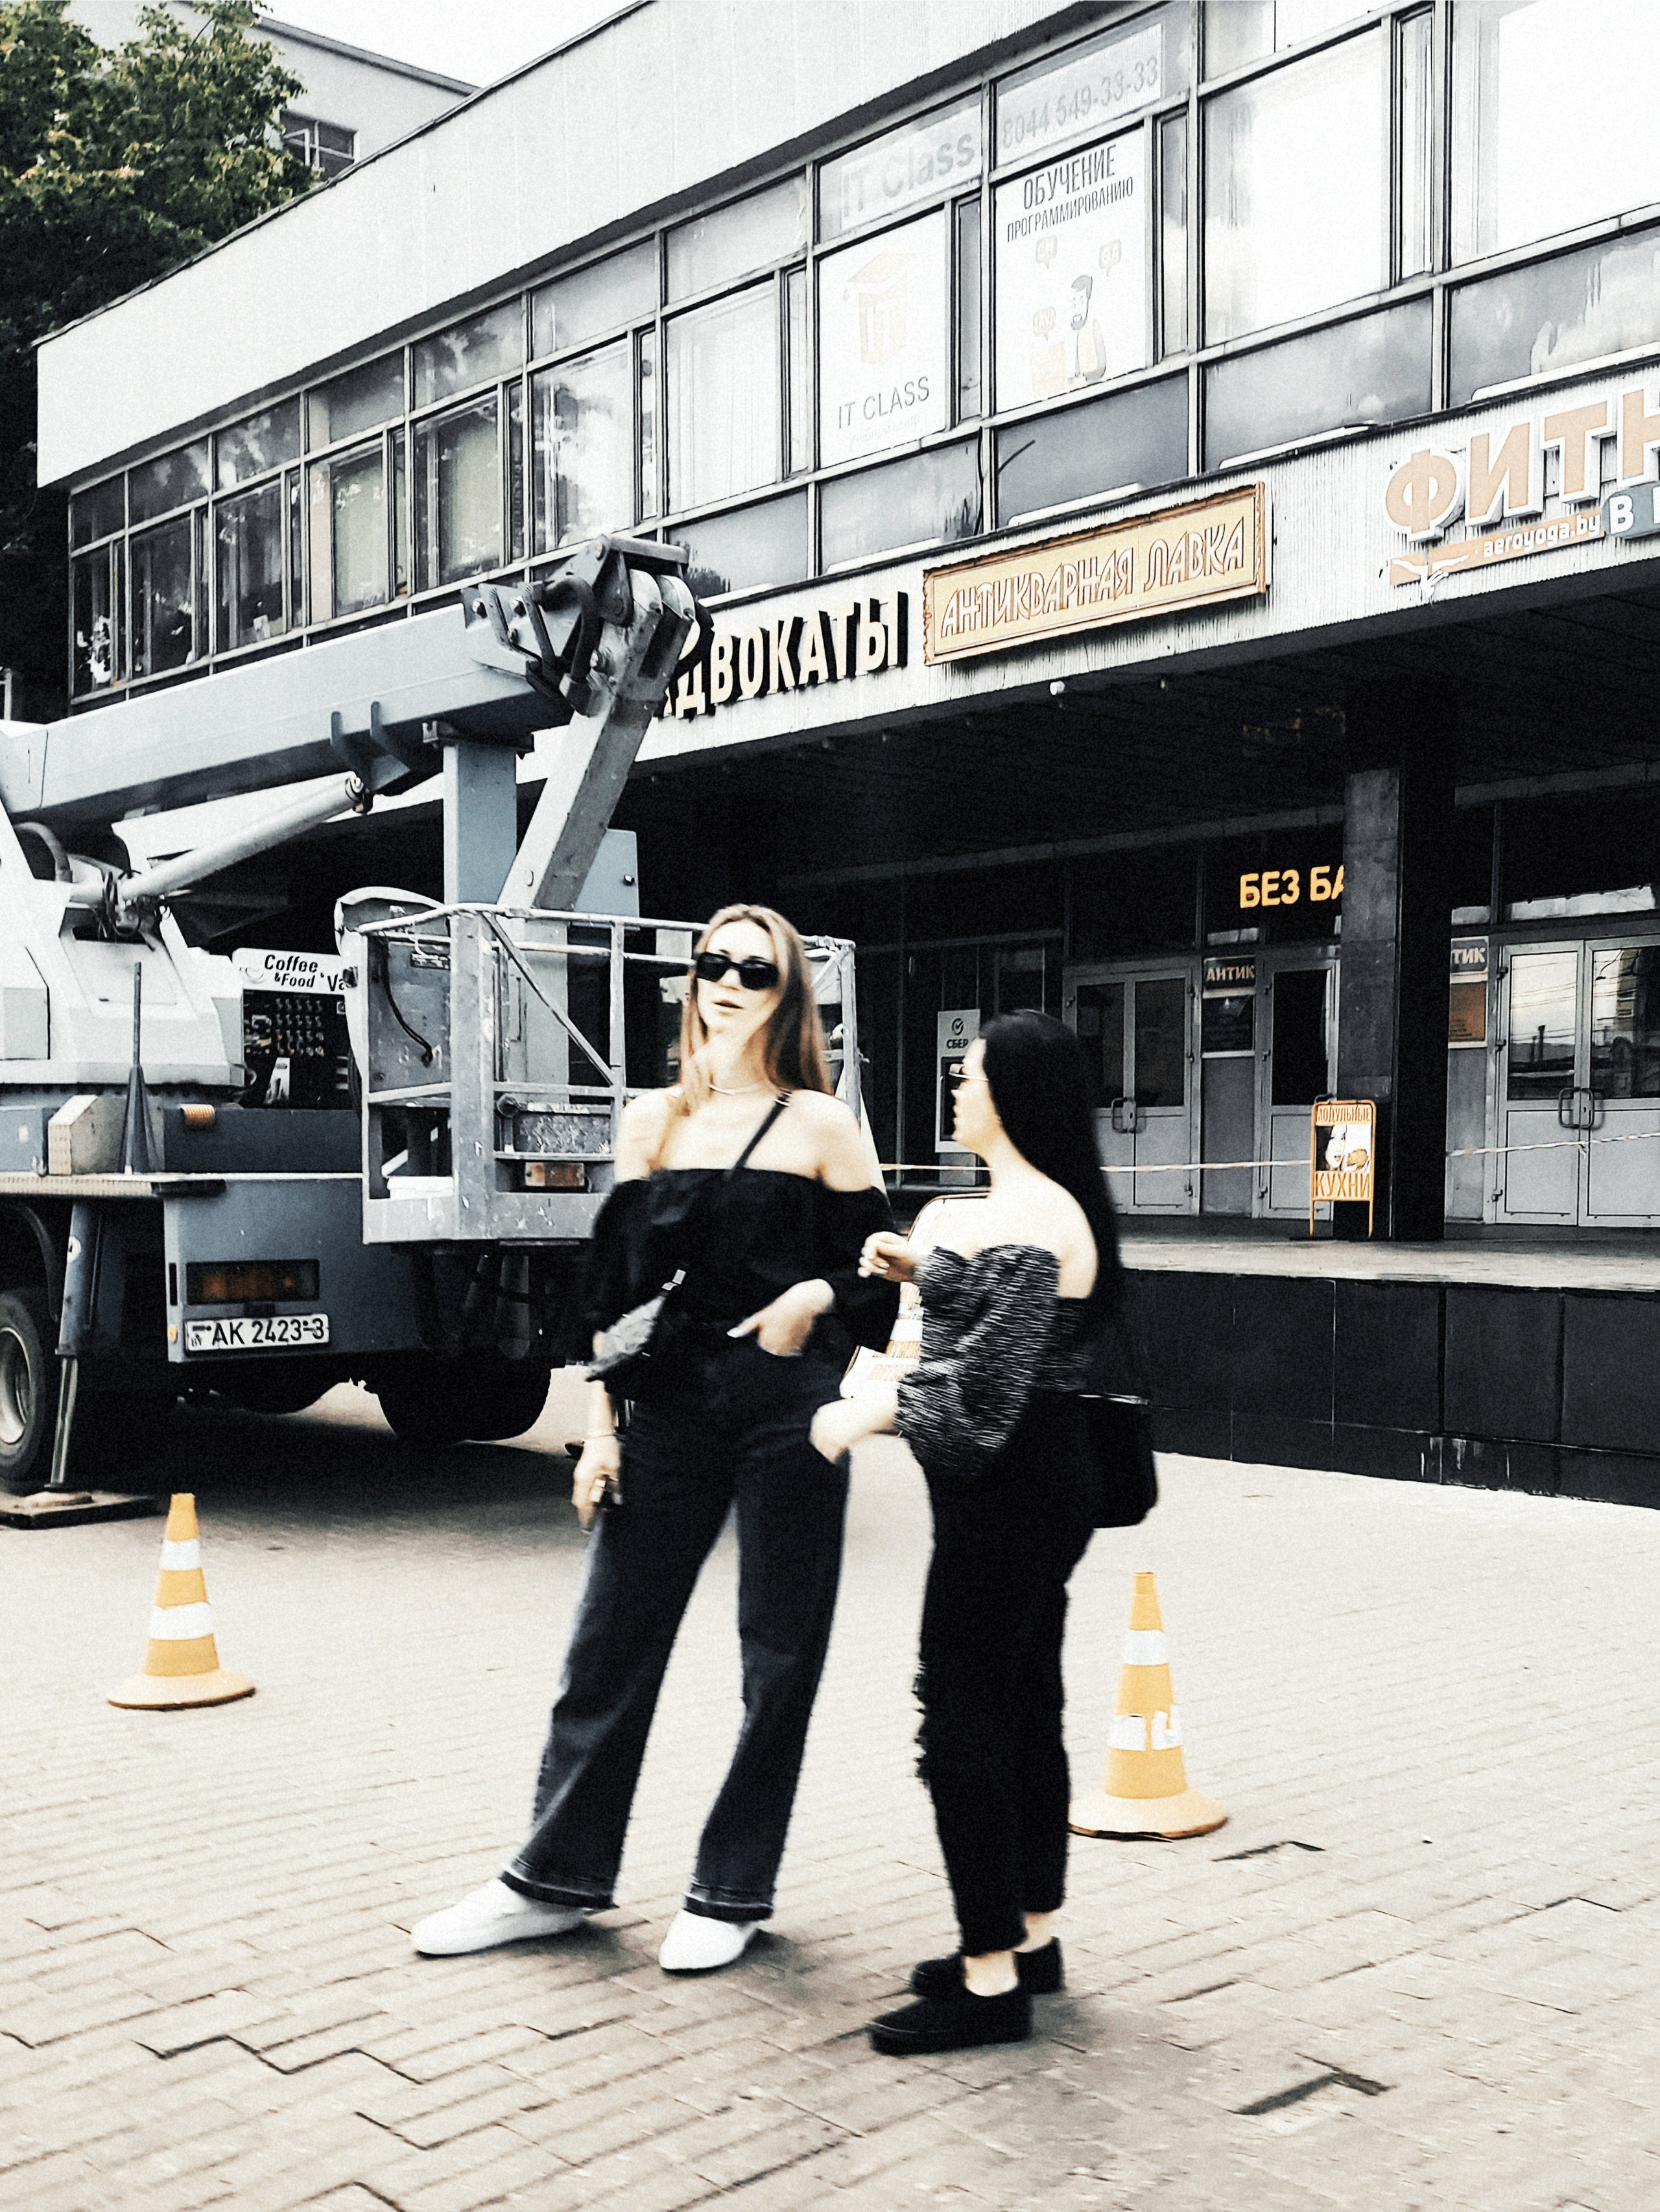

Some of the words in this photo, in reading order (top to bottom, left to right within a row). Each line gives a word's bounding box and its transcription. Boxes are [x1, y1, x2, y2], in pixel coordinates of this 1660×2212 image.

[1003, 101, 1049, 149] 8044
[1056, 54, 1157, 126] 549-33-33
[844, 163, 870, 217] IT
[883, 134, 974, 197] Class
[1024, 144, 1116, 209] ОБУЧЕНИЕ
[1008, 176, 1133, 243] ПРОГРАММИРОВАНИЮ
[839, 402, 855, 429] IT
[864, 376, 929, 420] CLASS
[1483, 514, 1601, 558] aeroyoga.by
[941, 547, 1134, 638] АНТИКВАРНАЯ
[1143, 516, 1244, 593] ЛАВКА
[663, 591, 899, 719] ДВОКАТЫ
[1239, 869, 1299, 908] БЕЗ
[264, 954, 319, 973] Coffee
[1206, 964, 1255, 982] АНТИК
[946, 1038, 969, 1049] СБЕР
[1316, 1106, 1371, 1123] МОДУЛЬНЫЕ
[1315, 1172, 1370, 1198] КУХНИ
